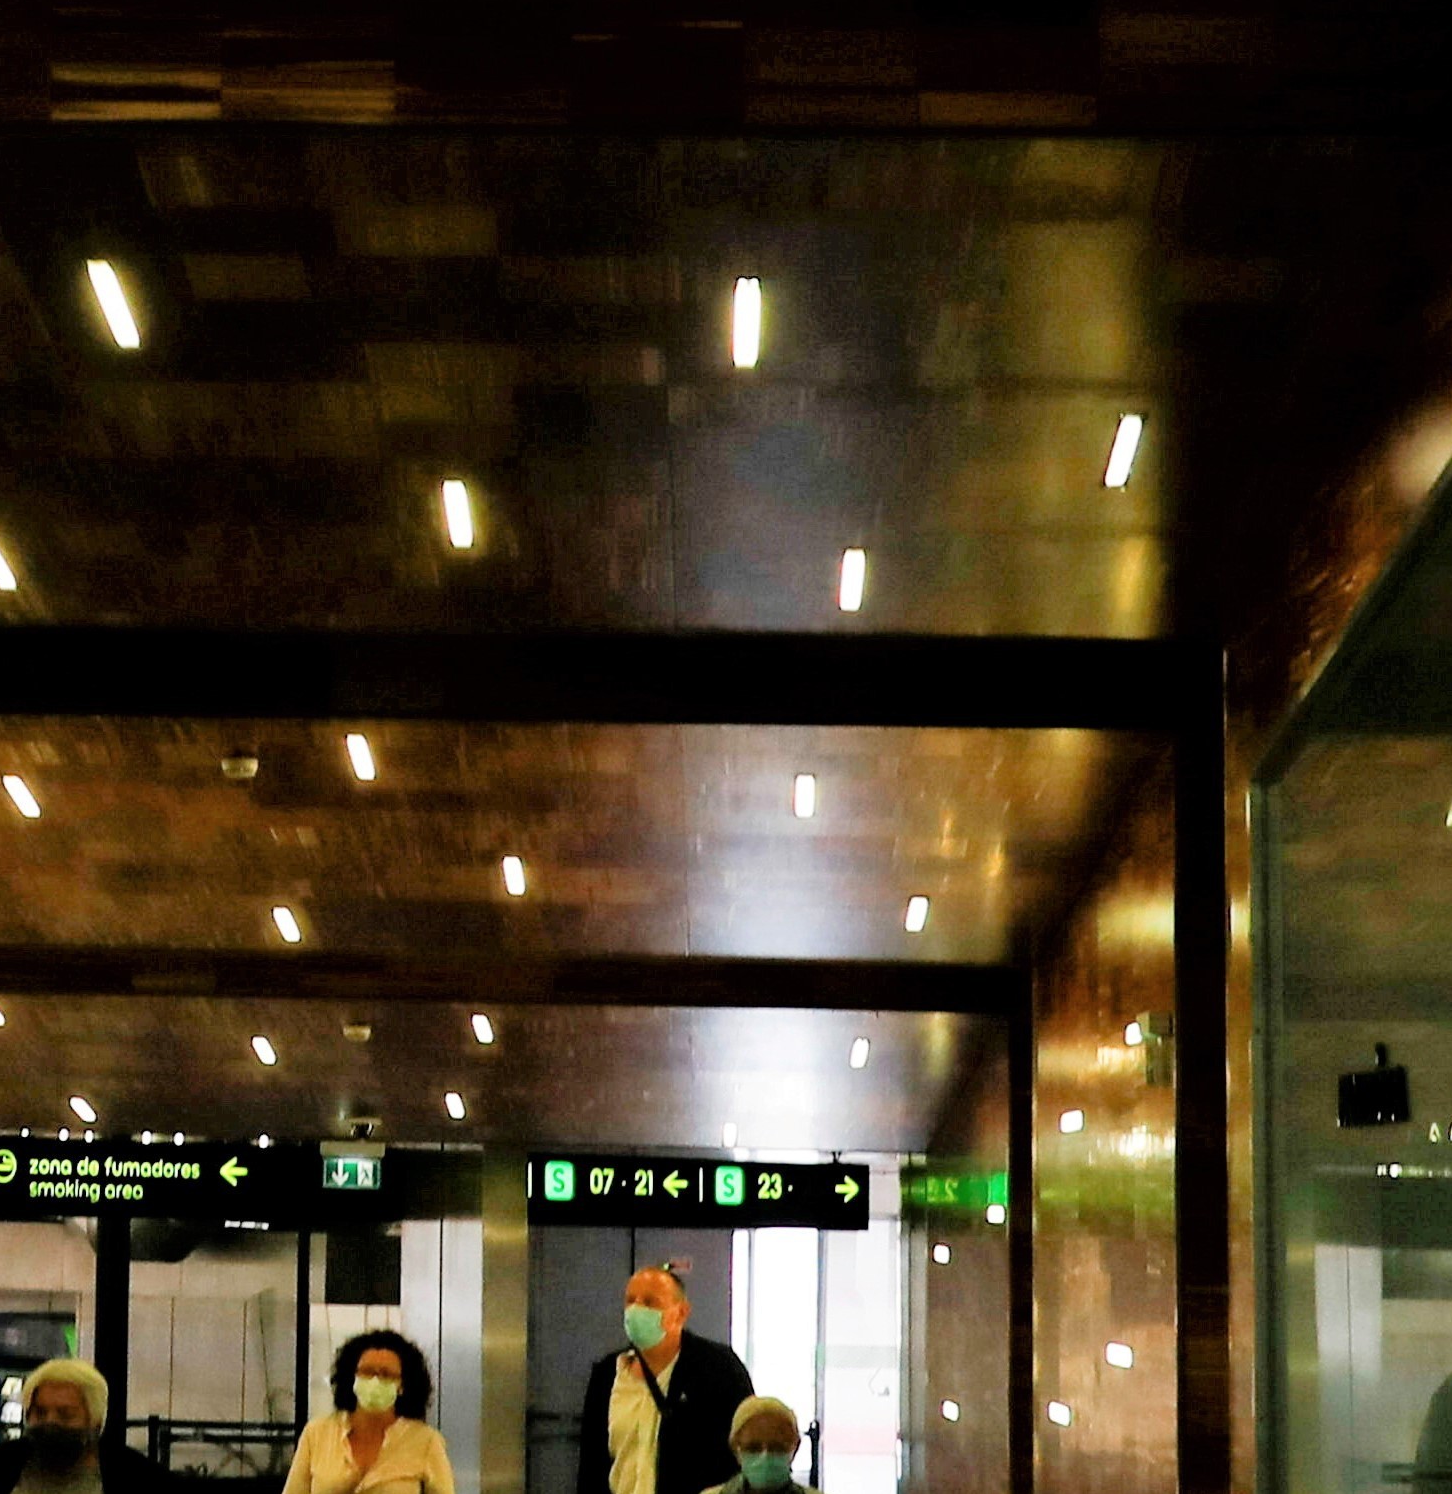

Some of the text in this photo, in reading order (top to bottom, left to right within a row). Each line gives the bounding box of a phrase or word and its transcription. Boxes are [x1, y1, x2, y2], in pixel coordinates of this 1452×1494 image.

[29, 1155, 201, 1180] zona de fumadores
[551, 1166, 566, 1194] S
[589, 1167, 615, 1195] 07
[29, 1178, 145, 1203] smoking area
[721, 1172, 735, 1198] S
[757, 1172, 784, 1200] 23
